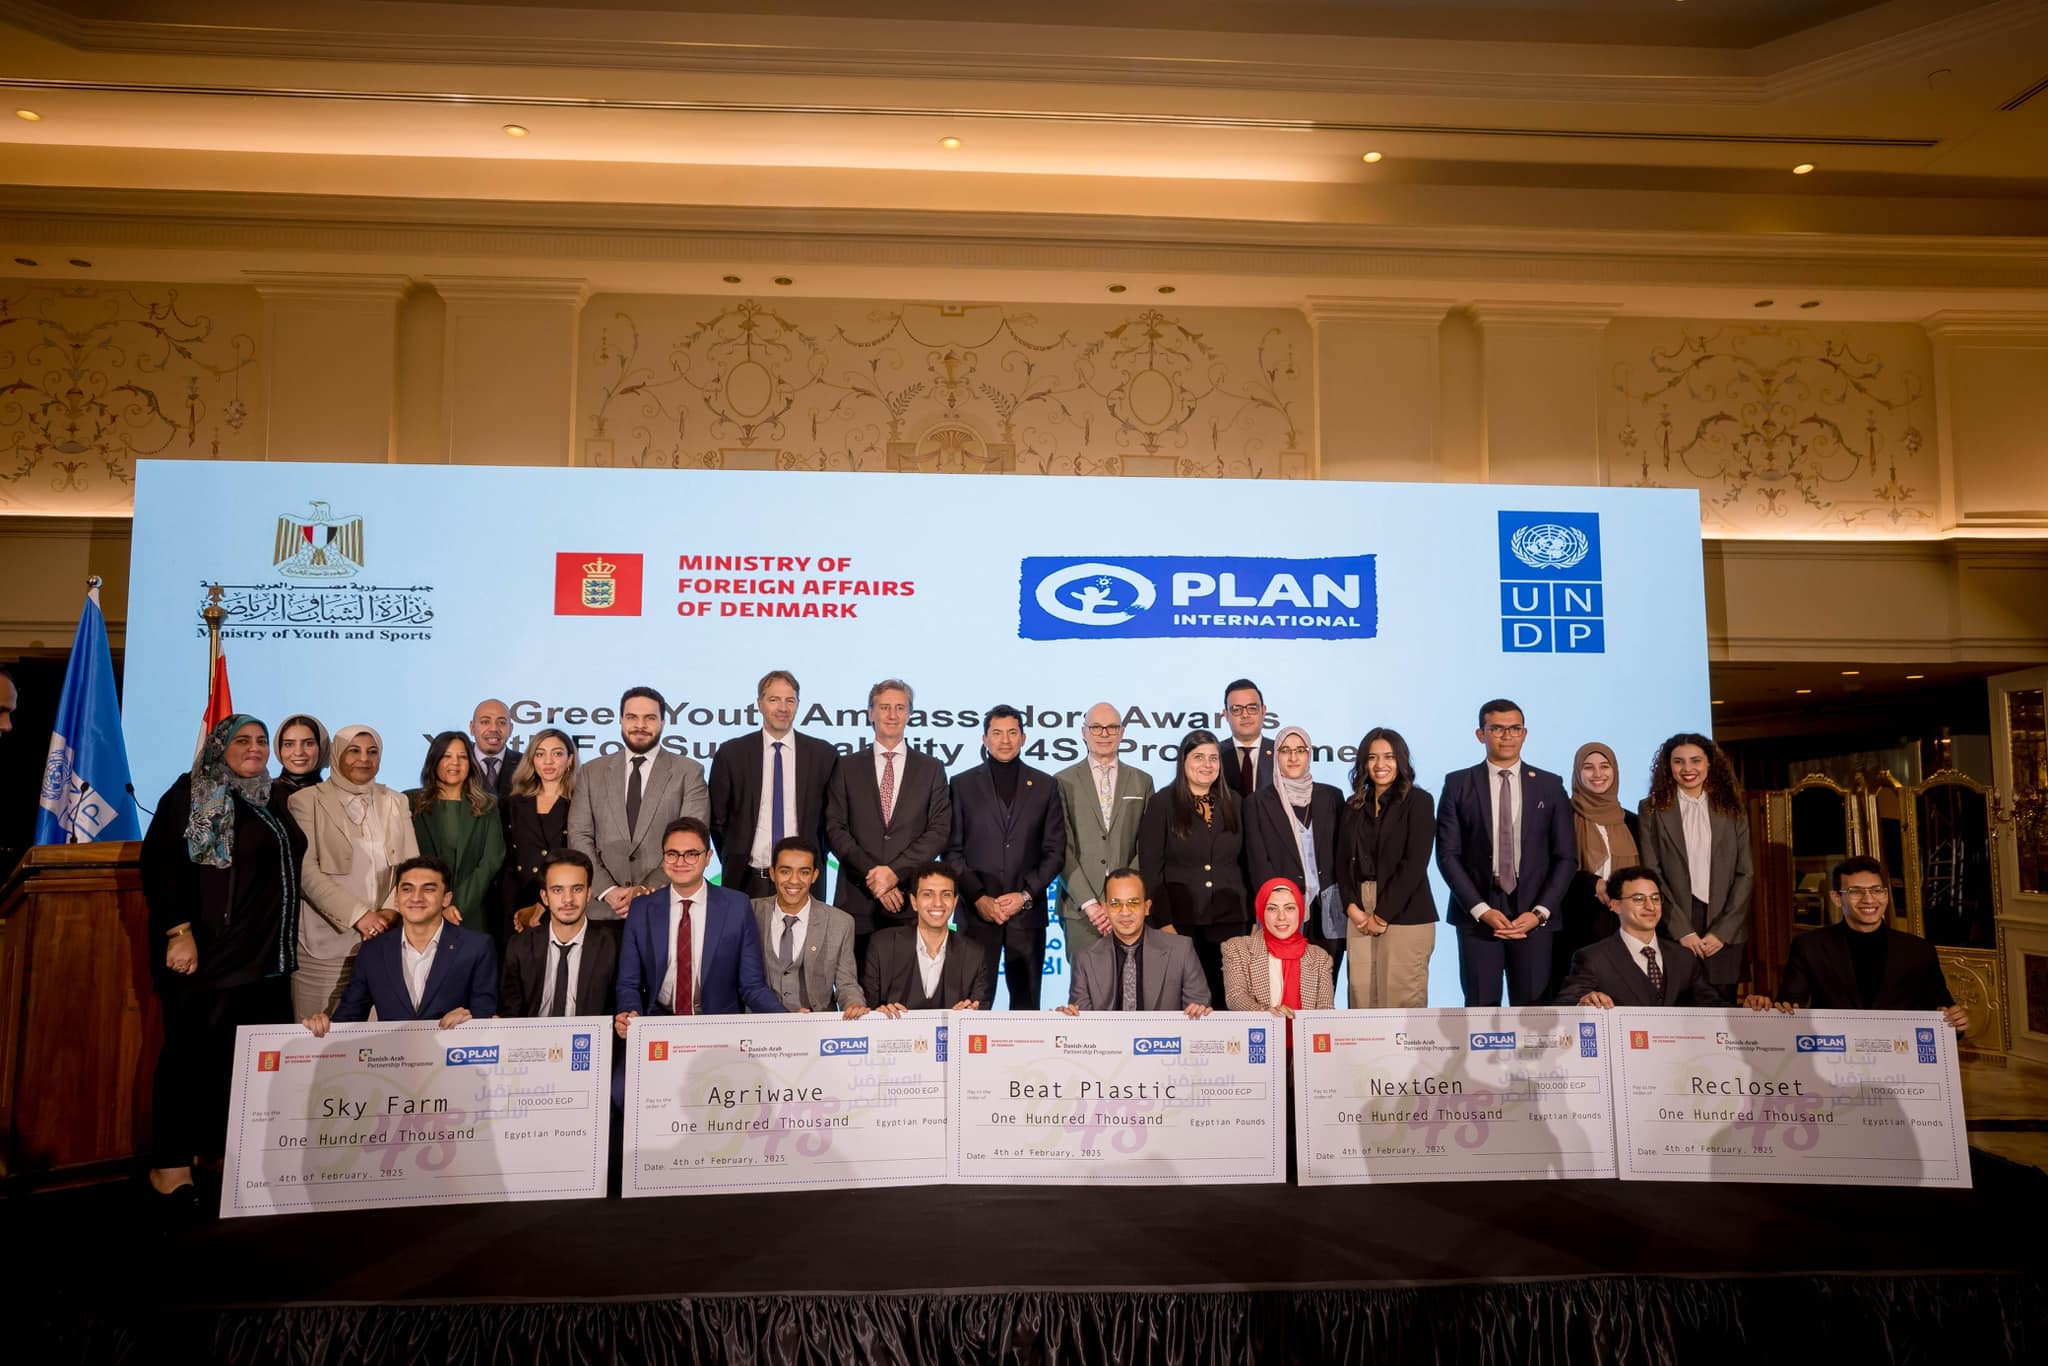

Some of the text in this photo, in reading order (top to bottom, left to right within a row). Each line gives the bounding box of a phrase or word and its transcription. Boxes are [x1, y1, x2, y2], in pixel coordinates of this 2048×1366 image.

[679, 555, 852, 572] MINISTRY OF
[678, 578, 915, 596] FOREIGN AFFAIRS
[1172, 572, 1361, 608] PLAN
[677, 602, 858, 618] OF DENMARK
[1173, 614, 1360, 627] INTERNATIONAL
[196, 628, 431, 641] Mnistry of Youth and Sports
[510, 700, 616, 725] Gree
[665, 702, 759, 726] Yout
[1122, 706, 1280, 729] Awars
[572, 735, 625, 756] Fo
[840, 1040, 867, 1050] PLAN
[1153, 1040, 1179, 1049] PLAN
[1489, 1035, 1514, 1044] PLAN
[1817, 1038, 1844, 1047] PLAN
[468, 1049, 497, 1060] PLAN
[922, 1086, 939, 1095] EGP
[1009, 1080, 1176, 1099] Beat Plastic
[1370, 1077, 1463, 1096] NextGen
[1570, 1081, 1586, 1089] EGP
[1692, 1077, 1803, 1096] Recloset
[708, 1085, 823, 1108] Agriwave
[1235, 1088, 1252, 1096] EGP
[1908, 1088, 1925, 1096] EGP
[555, 1097, 574, 1105] EGP
[323, 1096, 449, 1120] Sky Farm
[991, 1113, 1163, 1125] One Hundred Thousand
[1338, 1108, 1503, 1122] One Hundred Thousand
[1528, 1112, 1567, 1121] Egyptian
[1659, 1108, 1833, 1123] One Hundred Thousand
[671, 1115, 849, 1133] One Hundred Thousand
[876, 1118, 917, 1128] Egyptian
[1190, 1118, 1266, 1127] Egyptian Pounds
[1862, 1118, 1943, 1127] Egyptian Pounds
[279, 1128, 474, 1147] One Hundred Thousand
[504, 1129, 587, 1140] Egyptian Pounds
[993, 1149, 1009, 1157] 4th
[1014, 1149, 1024, 1157] of
[1081, 1149, 1101, 1158] 2025
[1363, 1147, 1372, 1155] of
[1426, 1145, 1446, 1153] 2025
[1665, 1145, 1680, 1153] 4th
[1685, 1145, 1695, 1153] of
[1753, 1146, 1773, 1154] 2025
[673, 1158, 689, 1166] 4th
[694, 1157, 705, 1165] of
[764, 1154, 785, 1163] 2025
[279, 1174, 297, 1183] 4th
[302, 1173, 314, 1182] of
[380, 1169, 404, 1178] 2025
